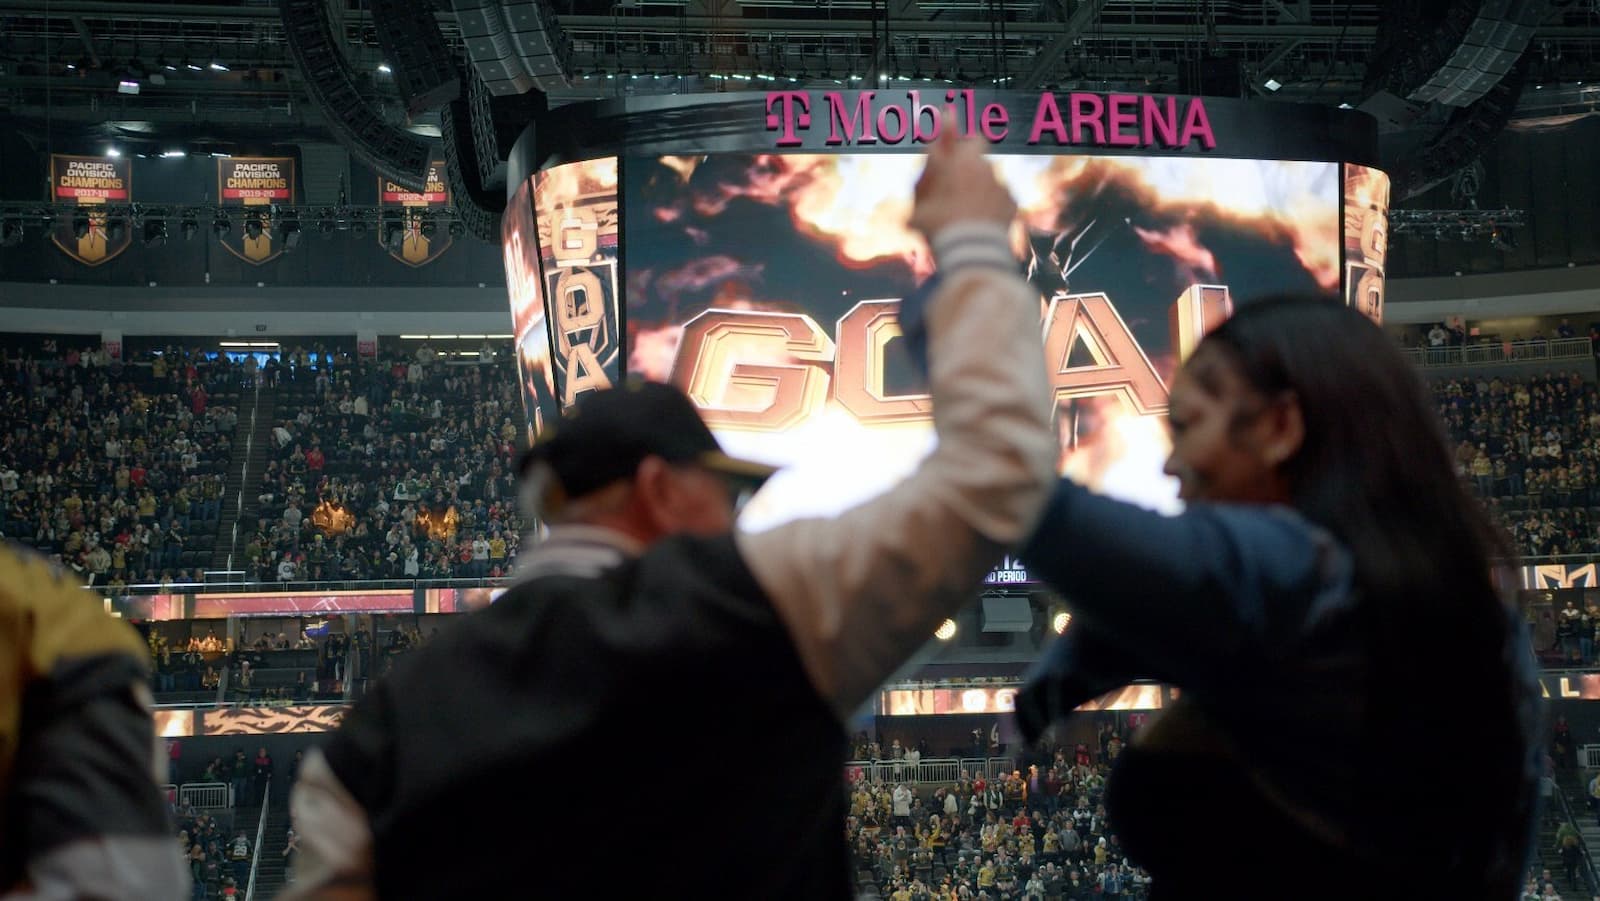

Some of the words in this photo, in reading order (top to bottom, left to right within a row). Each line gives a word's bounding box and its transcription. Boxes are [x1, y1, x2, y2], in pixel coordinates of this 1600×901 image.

[766, 91, 811, 147] T
[825, 89, 1010, 145] Mobile
[1027, 92, 1218, 150] ARENA
[69, 162, 114, 171] PACIFIC
[235, 163, 278, 171] PACIFIC
[67, 169, 116, 178] DIVISION
[61, 176, 123, 189] CHAMPIONS
[227, 178, 287, 189] CHAMPIONS
[74, 188, 109, 198] 2017-18
[239, 190, 276, 198] 2019-20
[997, 570, 1027, 582] PERIOD
